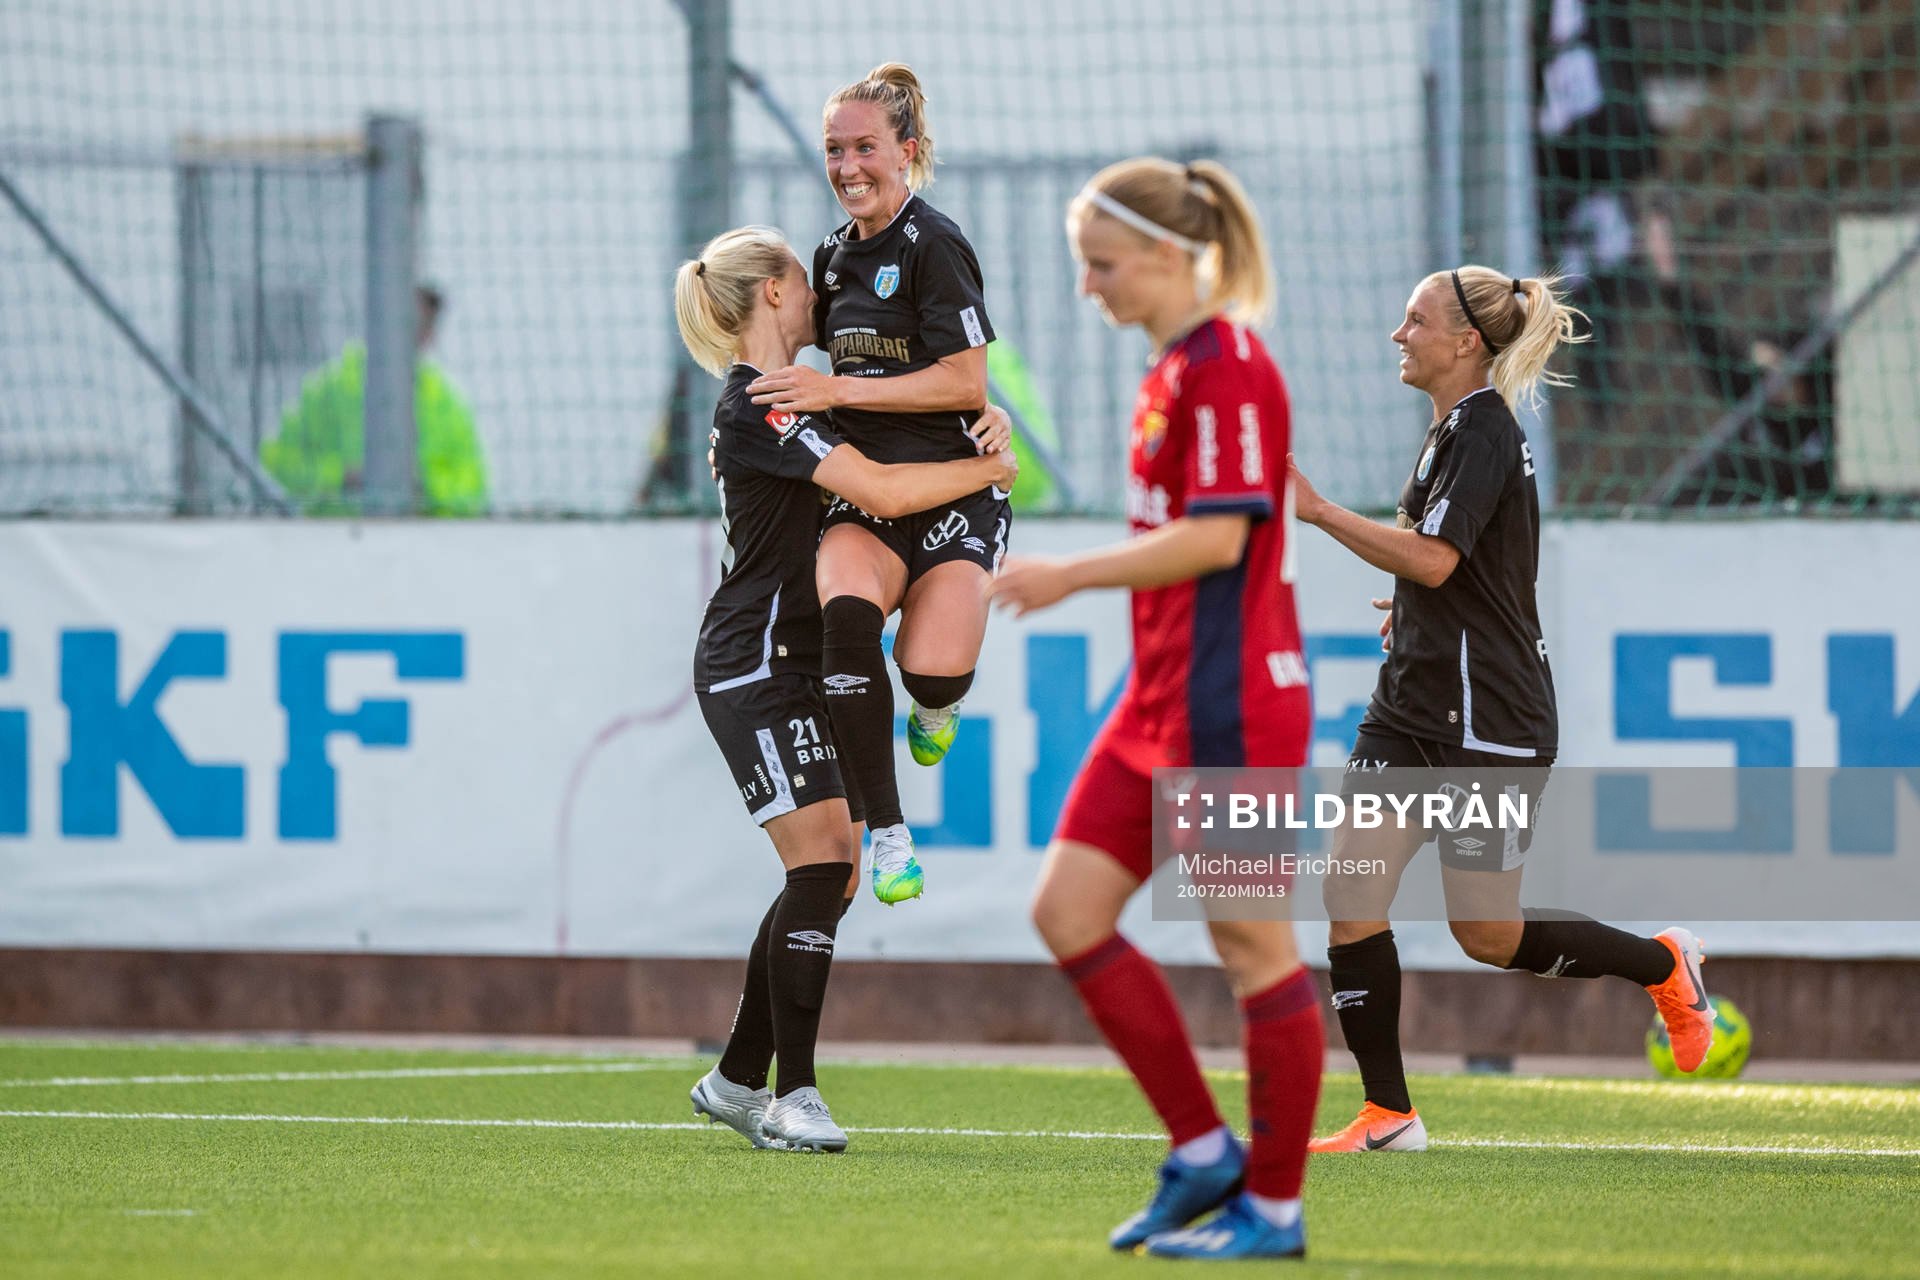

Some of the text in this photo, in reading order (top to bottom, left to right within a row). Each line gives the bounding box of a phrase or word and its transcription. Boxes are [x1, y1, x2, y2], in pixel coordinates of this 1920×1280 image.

[828, 334, 910, 364] OPPARBERG
[0, 629, 466, 841] KF
[788, 716, 820, 748] 21
[753, 763, 772, 795] umbro
[1455, 848, 1483, 858] umbro
[786, 943, 832, 955] umbro
